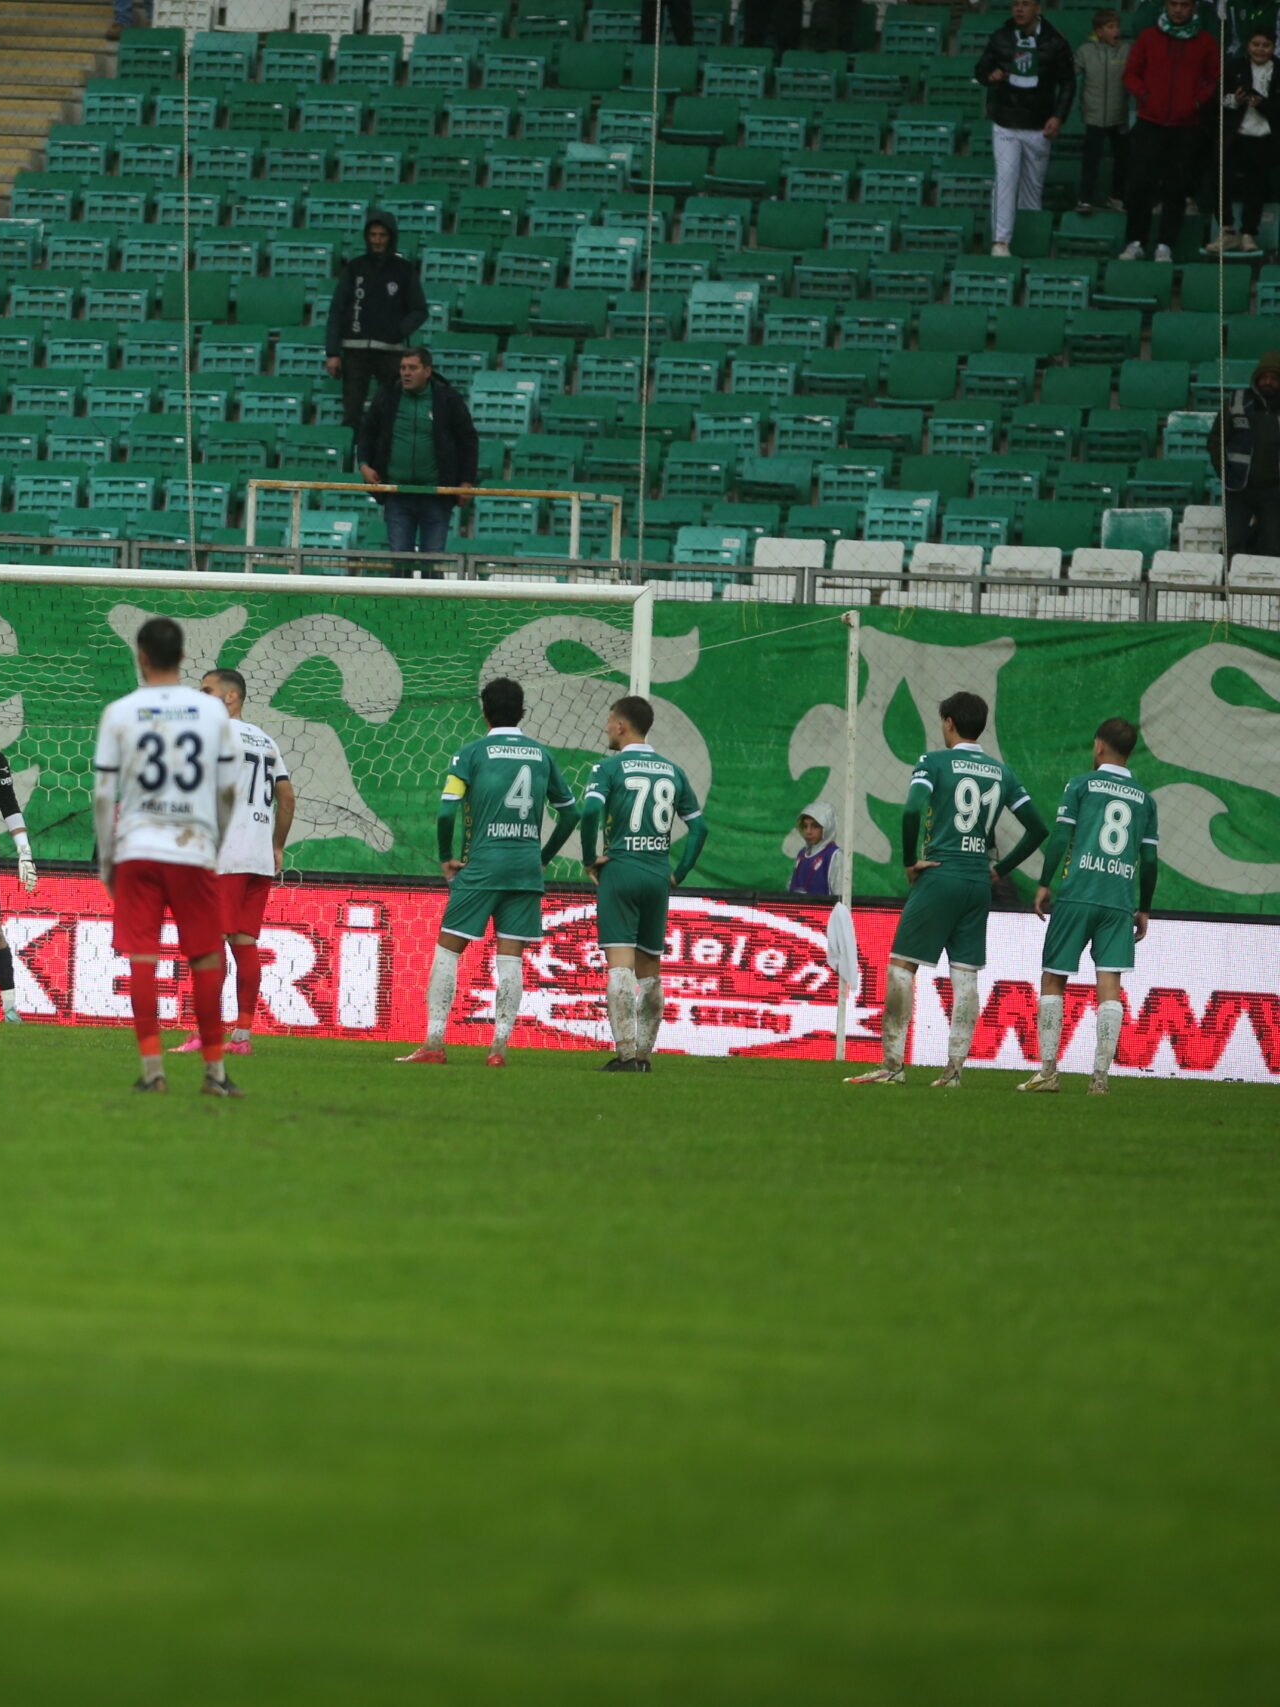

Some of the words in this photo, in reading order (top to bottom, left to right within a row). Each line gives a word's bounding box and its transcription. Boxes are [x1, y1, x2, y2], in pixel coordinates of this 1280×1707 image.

[137, 731, 203, 792] 33
[488, 746, 541, 758] DOWNTOWN
[623, 760, 674, 772] DOWNTOWN
[953, 760, 1001, 776] DOWNTOWN
[244, 752, 276, 808] 75
[504, 764, 534, 820] 4
[1089, 780, 1144, 800] DOWNTOWN
[624, 775, 676, 834] 78
[953, 776, 1001, 836] 91
[487, 823, 521, 838] FURKAN
[961, 836, 986, 853] ENES
[1098, 799, 1132, 856] 8
[1079, 852, 1106, 873] BİLAL
[522, 927, 832, 992] Kadelen
